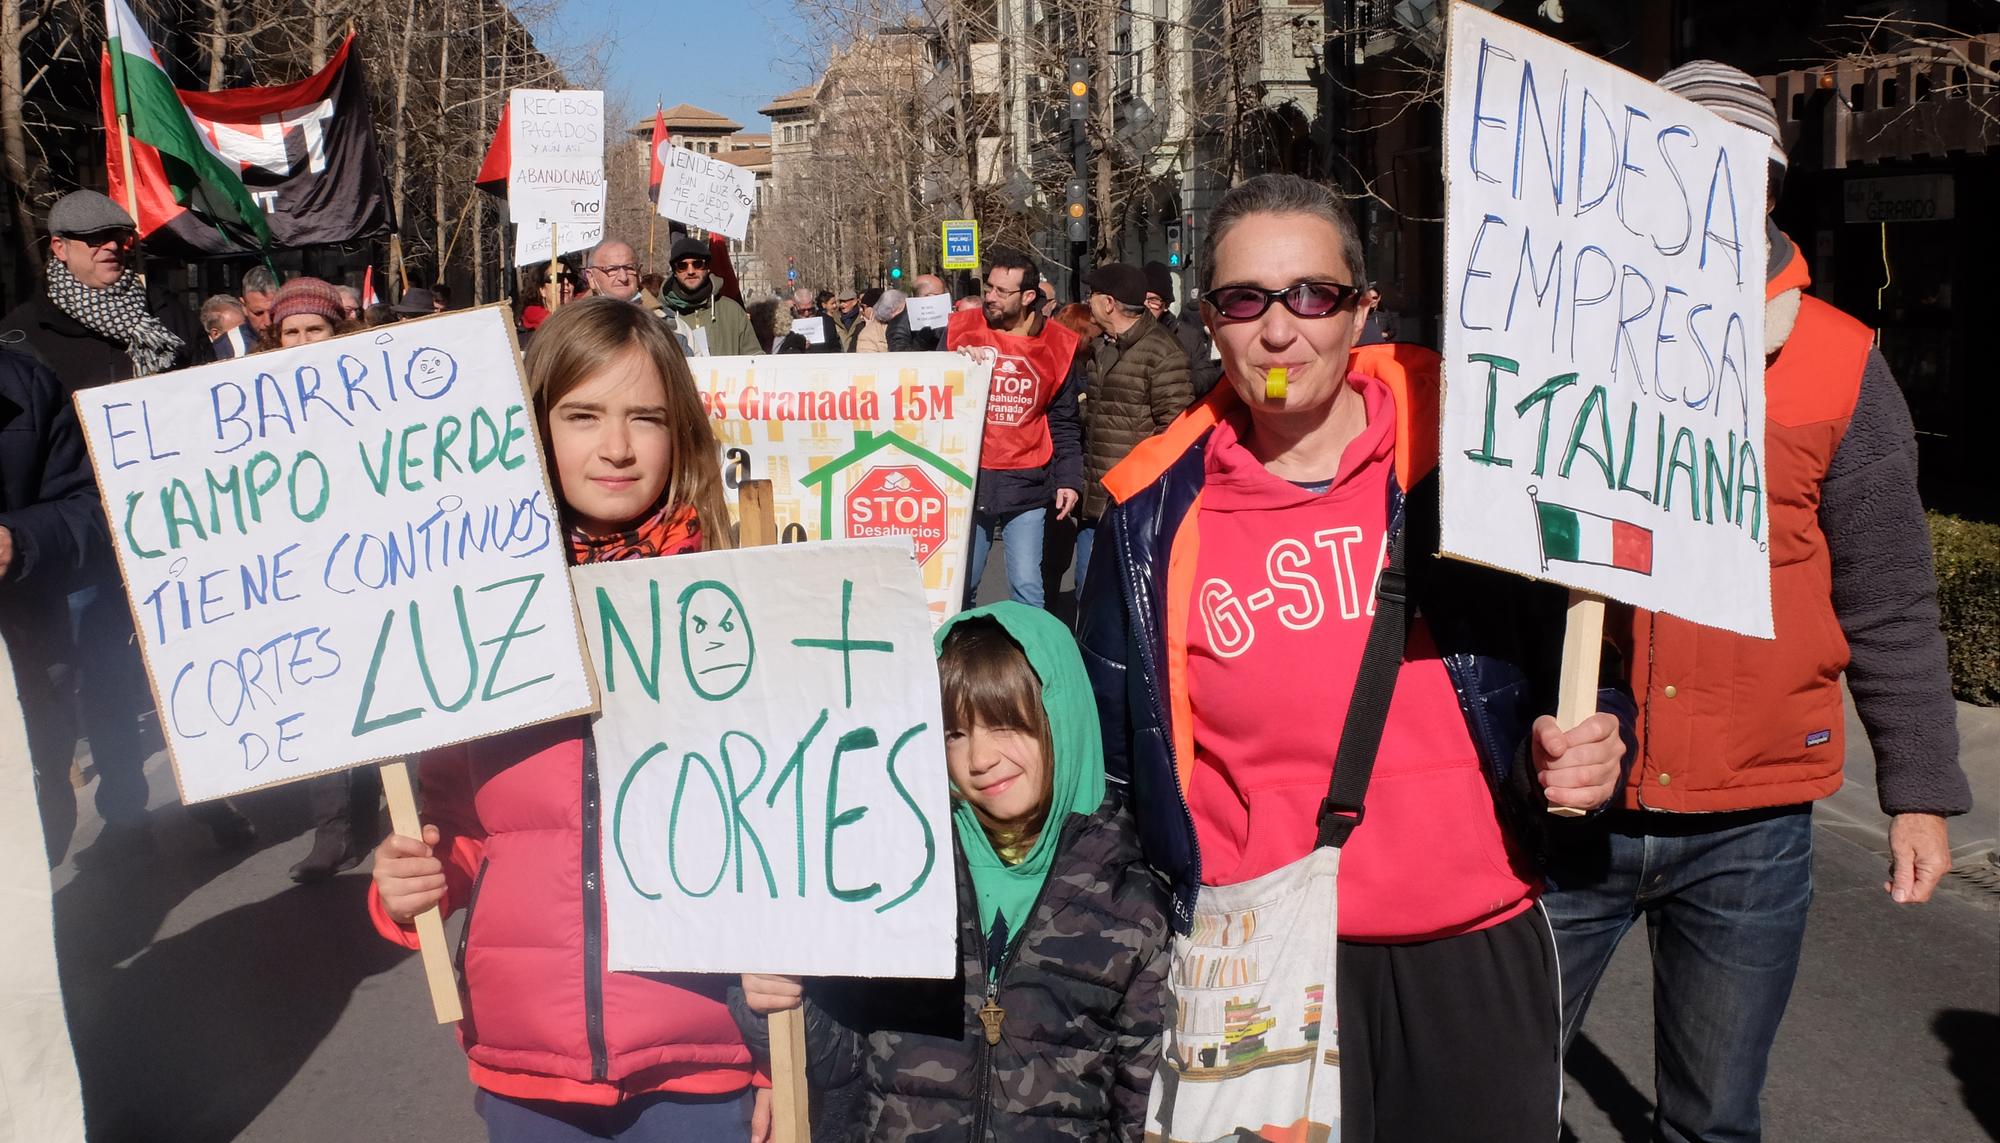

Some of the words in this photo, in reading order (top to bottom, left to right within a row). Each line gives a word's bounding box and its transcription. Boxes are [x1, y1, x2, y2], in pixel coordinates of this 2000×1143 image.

[523, 97, 599, 117] RECIBOS
[196, 98, 334, 177] NT
[521, 120, 598, 143] PAGADOS
[531, 144, 539, 153] Y
[1469, 38, 1744, 292] ENDESA
[673, 186, 690, 199] ME
[697, 192, 730, 211] QUEDO
[710, 182, 729, 199] LUZ
[1866, 198, 1937, 220] GERARDO
[951, 245, 970, 253] TAXI
[1459, 214, 1749, 438] EMPRESA
[993, 376, 1032, 394] TOP
[102, 399, 181, 471] EL
[210, 332, 458, 454] BARRIO
[738, 385, 880, 422] Granada
[890, 385, 955, 422] 15M
[988, 402, 1024, 414] ranada
[990, 395, 1032, 404] sahucios
[995, 413, 1005, 421] 15
[1006, 413, 1014, 421] M
[125, 448, 330, 560] CAMPO
[358, 404, 527, 498] VERDE
[851, 496, 941, 523] STOP
[853, 524, 941, 537] Desahucios
[143, 542, 302, 645] TIENE
[323, 490, 552, 595] CONTINUOS
[596, 579, 757, 704] NO
[171, 626, 342, 739] CORTES
[238, 712, 305, 771] DE
[351, 573, 556, 738] LUZ
[613, 708, 936, 914] CORTES
